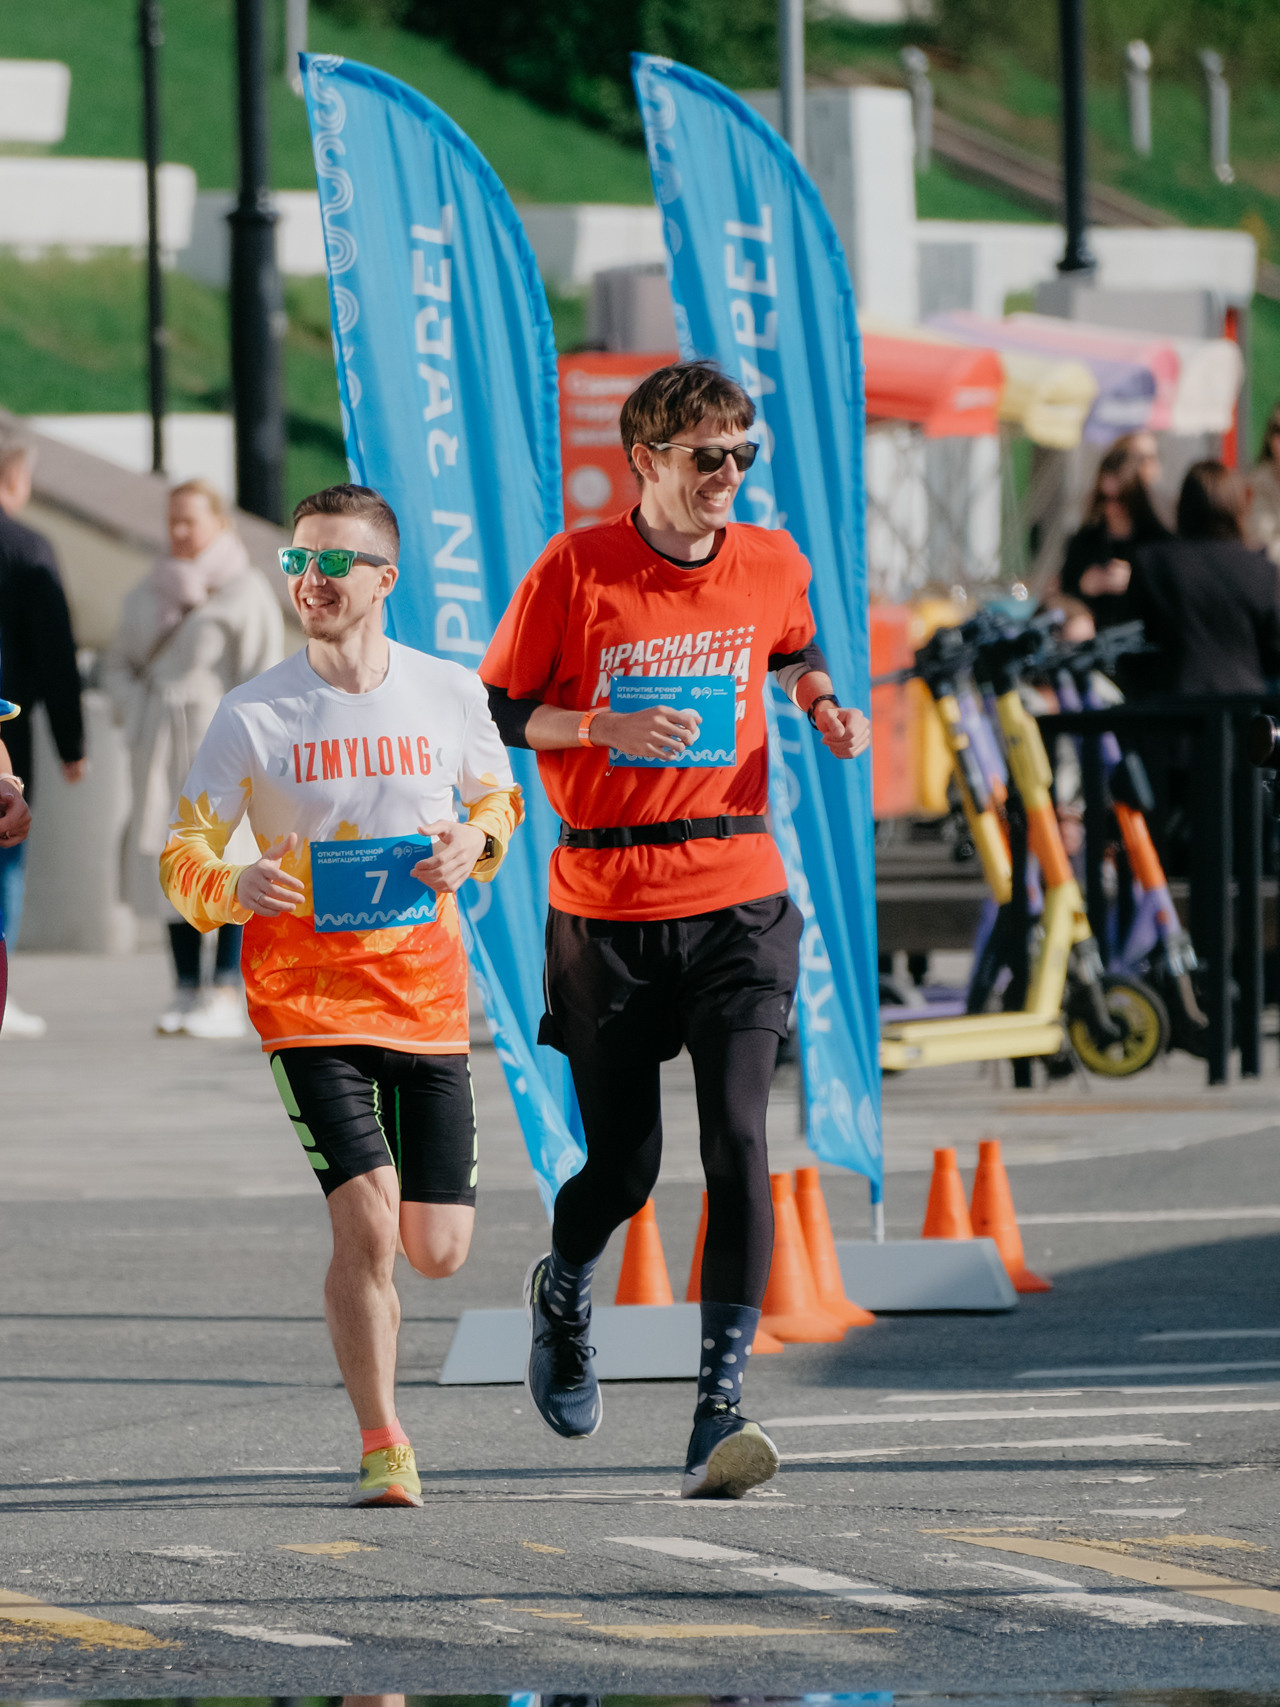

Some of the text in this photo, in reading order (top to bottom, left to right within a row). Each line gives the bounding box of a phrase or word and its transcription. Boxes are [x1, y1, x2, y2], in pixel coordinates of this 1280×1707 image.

[599, 630, 712, 671] КРАСНАЯ
[293, 735, 432, 783] IZMYLONG
[317, 847, 383, 858] ОТКРЫТИЕ РЕЧНОЙ
[318, 856, 361, 864] НАВИГАЦИИ
[365, 870, 389, 905] 7
